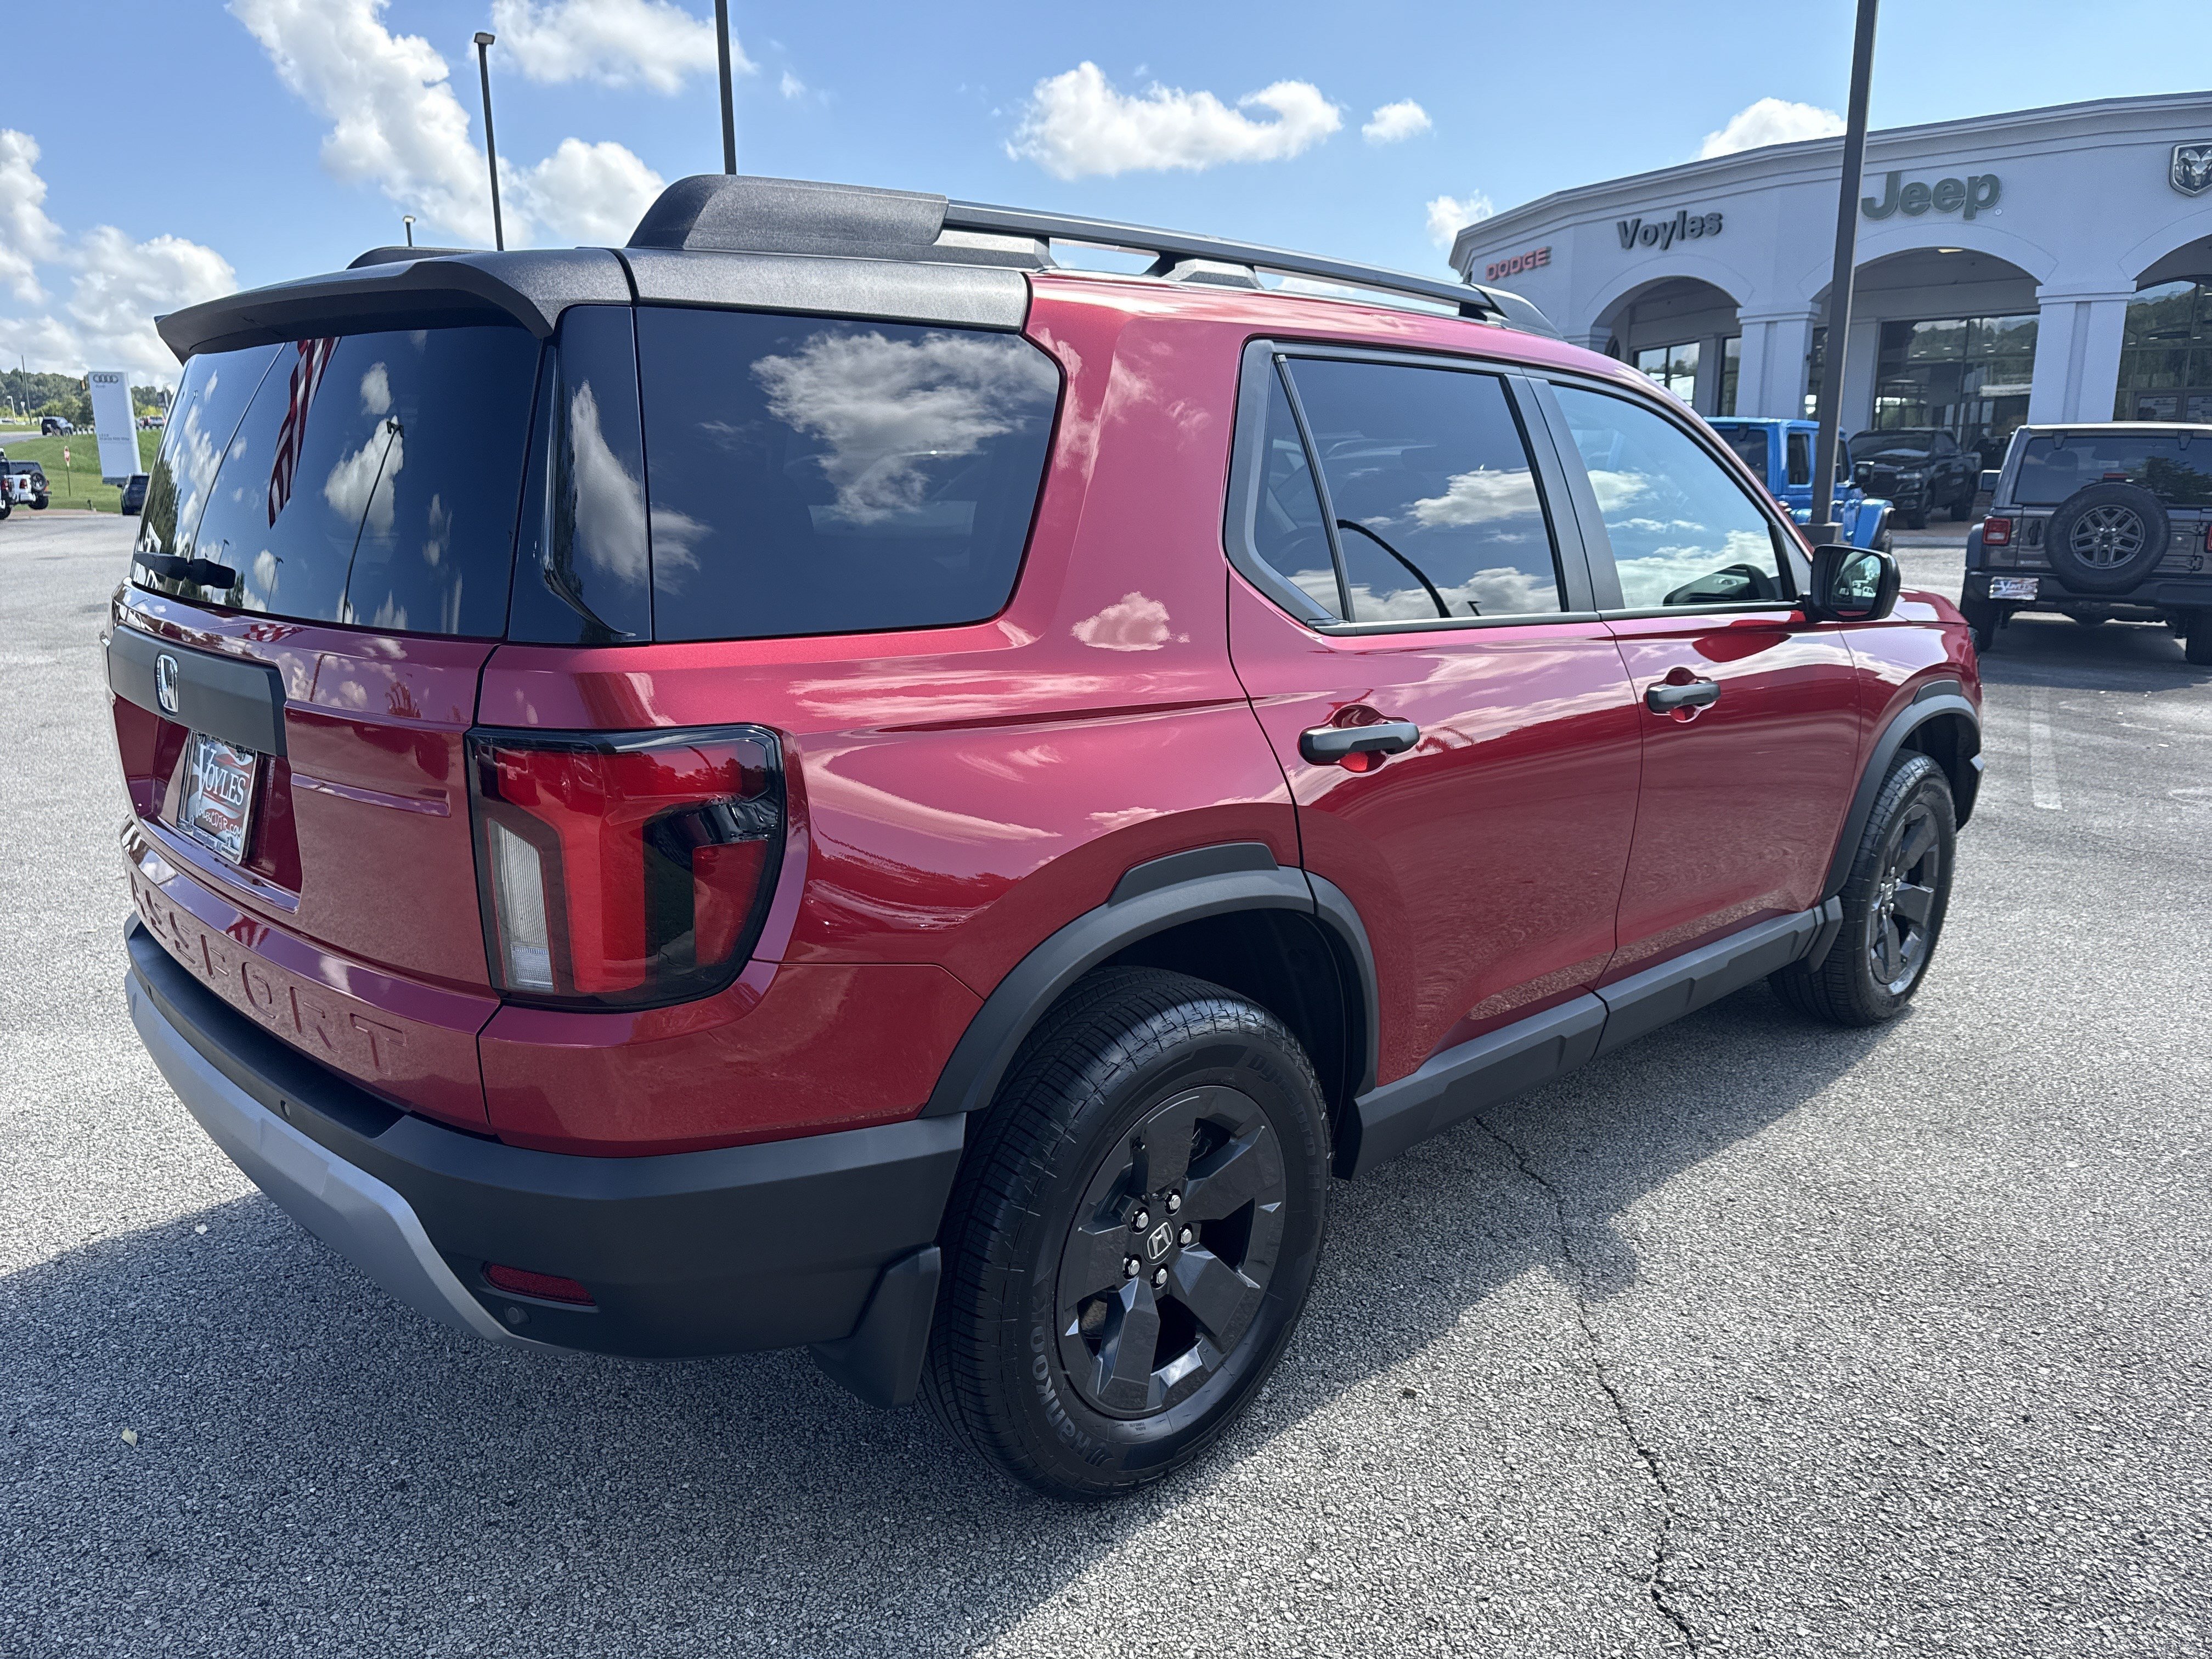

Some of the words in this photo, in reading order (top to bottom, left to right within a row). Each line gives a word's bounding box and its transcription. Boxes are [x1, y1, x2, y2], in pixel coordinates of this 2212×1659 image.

[1861, 171, 2001, 219] Jeep
[1617, 210, 1724, 250] Voyles
[1485, 245, 1551, 281] DODGE
[198, 743, 246, 806] VOYLES
[129, 871, 407, 1075] ASSPORT
